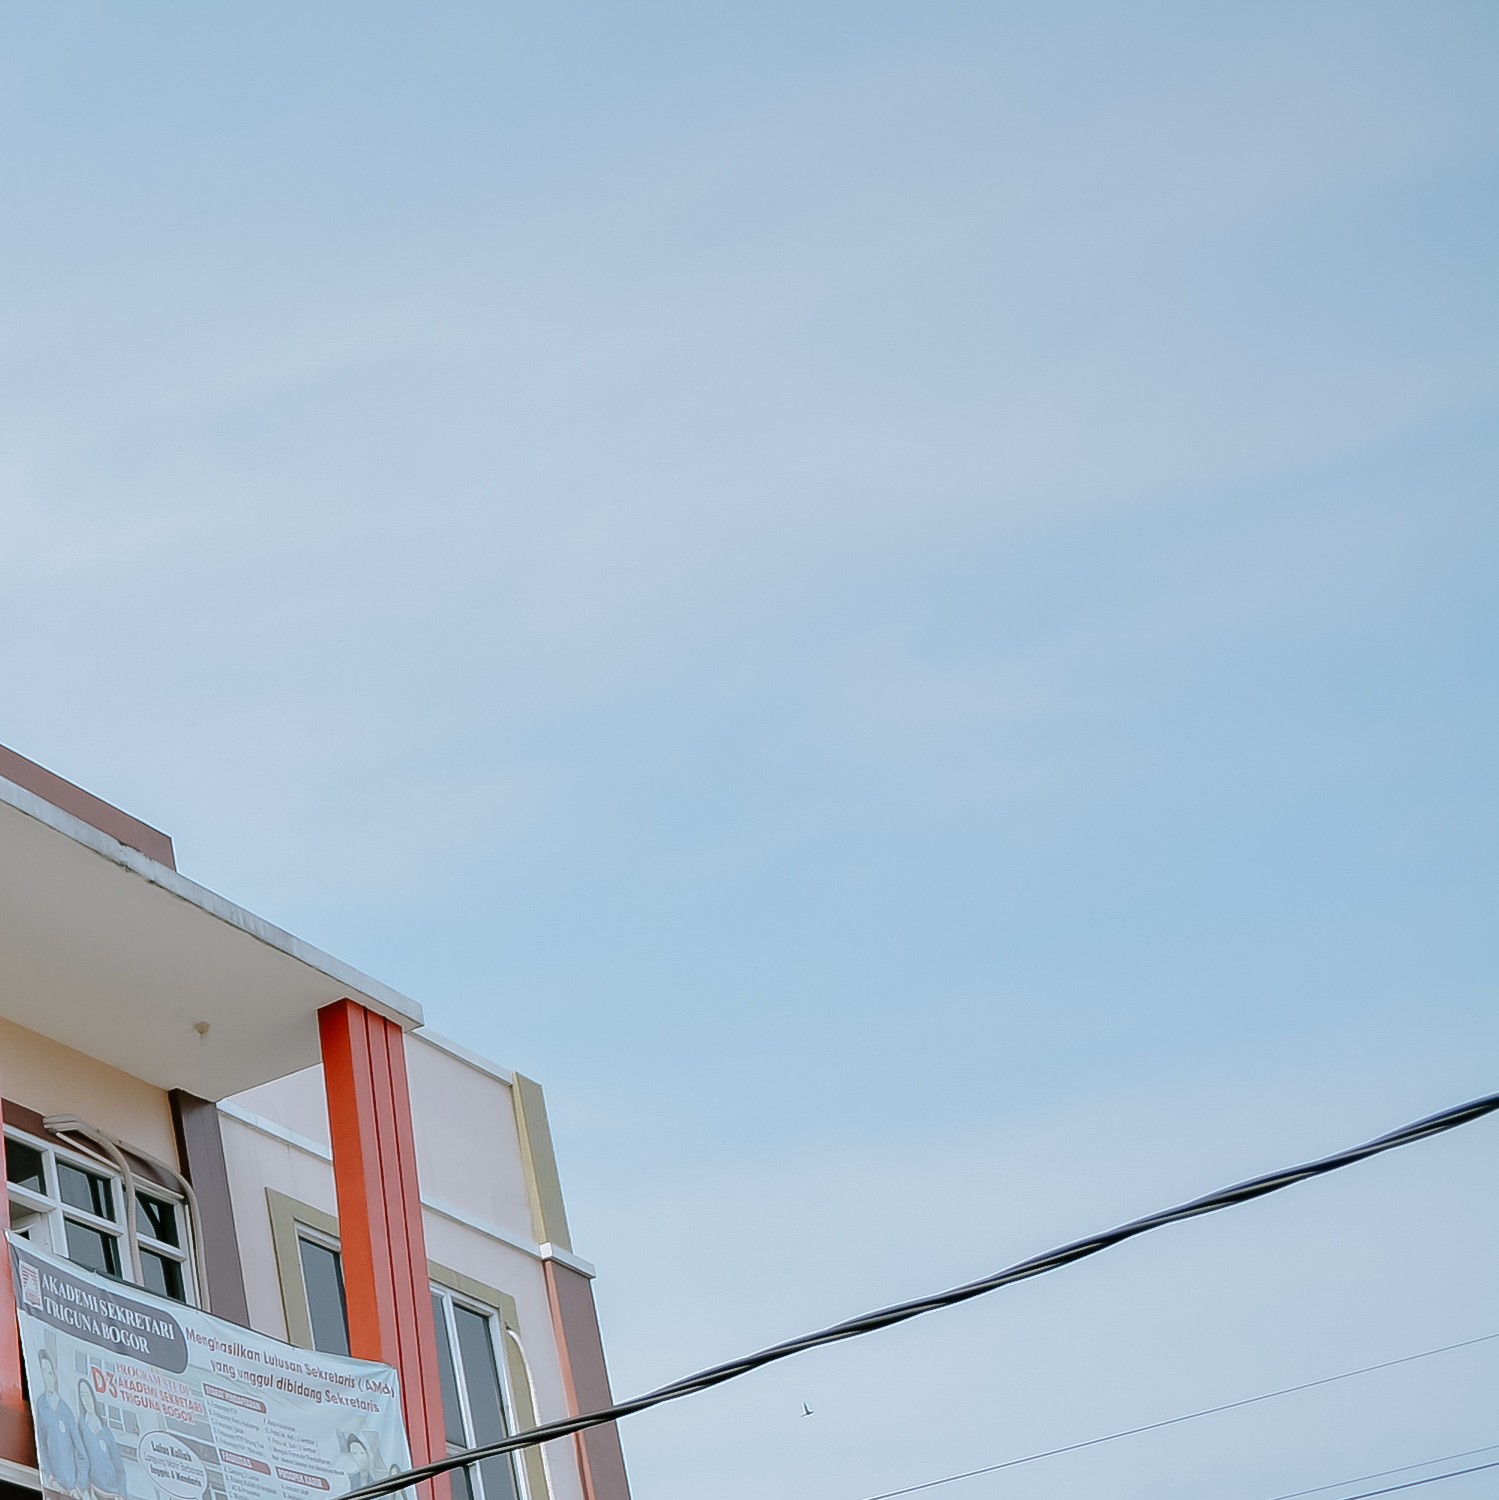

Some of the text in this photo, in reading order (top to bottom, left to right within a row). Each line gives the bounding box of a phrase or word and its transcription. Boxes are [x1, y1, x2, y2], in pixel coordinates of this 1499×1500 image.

[41, 1273, 175, 1340] AKADEMI SEKRETARI
[43, 1296, 151, 1354] TRIGUNA BOGOR
[91, 1365, 118, 1399] D3
[185, 1326, 261, 1363] Menghasilkan
[263, 1350, 303, 1374] Lulusan
[304, 1363, 356, 1389] Sekretaris
[118, 1376, 158, 1397] AKADEMI
[159, 1389, 203, 1414] SEKRETARI
[119, 1389, 195, 1424] TRIGUNA BOGOR
[209, 1358, 236, 1379] yang
[237, 1368, 274, 1388] unggul
[276, 1376, 322, 1403] dibidang
[324, 1389, 381, 1413] Sekretaris
